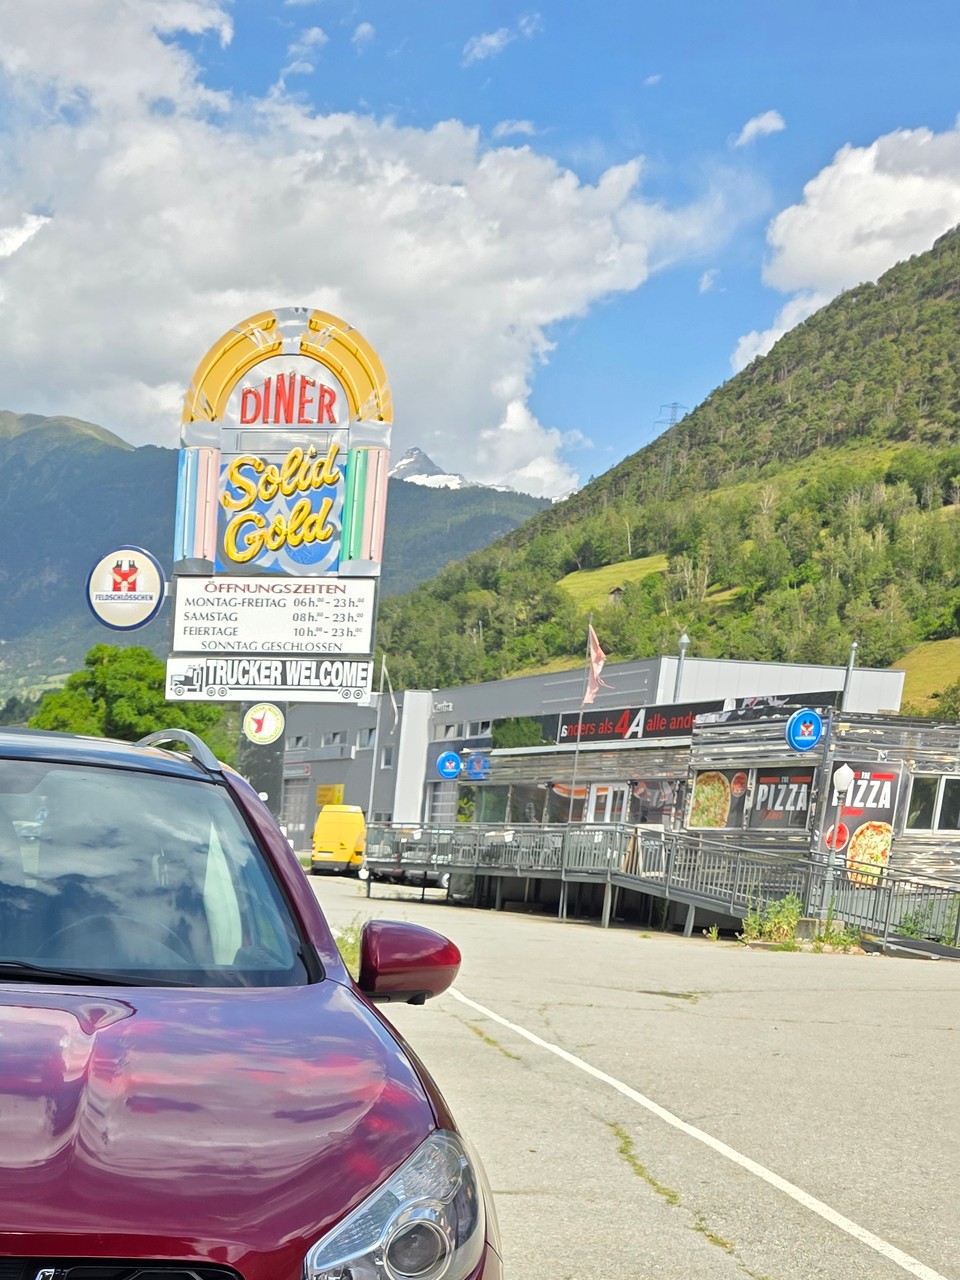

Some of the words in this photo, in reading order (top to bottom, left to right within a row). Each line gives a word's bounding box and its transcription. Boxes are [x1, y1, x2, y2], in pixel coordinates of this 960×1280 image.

[240, 371, 338, 425] DINER
[222, 443, 341, 511] Solid
[223, 498, 334, 564] Gold
[204, 581, 347, 594] ÖFFNUNGSZEITEN
[95, 593, 154, 601] FELDSCHLÖSSCHEN
[185, 598, 287, 608] MONTAG-FREITAG
[183, 612, 238, 622] SAMSTAG
[183, 626, 239, 637] FEIERTAGE
[201, 640, 258, 651] SONNTAG
[261, 641, 343, 652] GESCHLOSSEN
[206, 659, 283, 686] TRUCKER
[285, 660, 369, 688] WELCOME
[598, 717, 613, 734] als
[646, 713, 667, 731] alle
[756, 783, 808, 811] PIZZA
